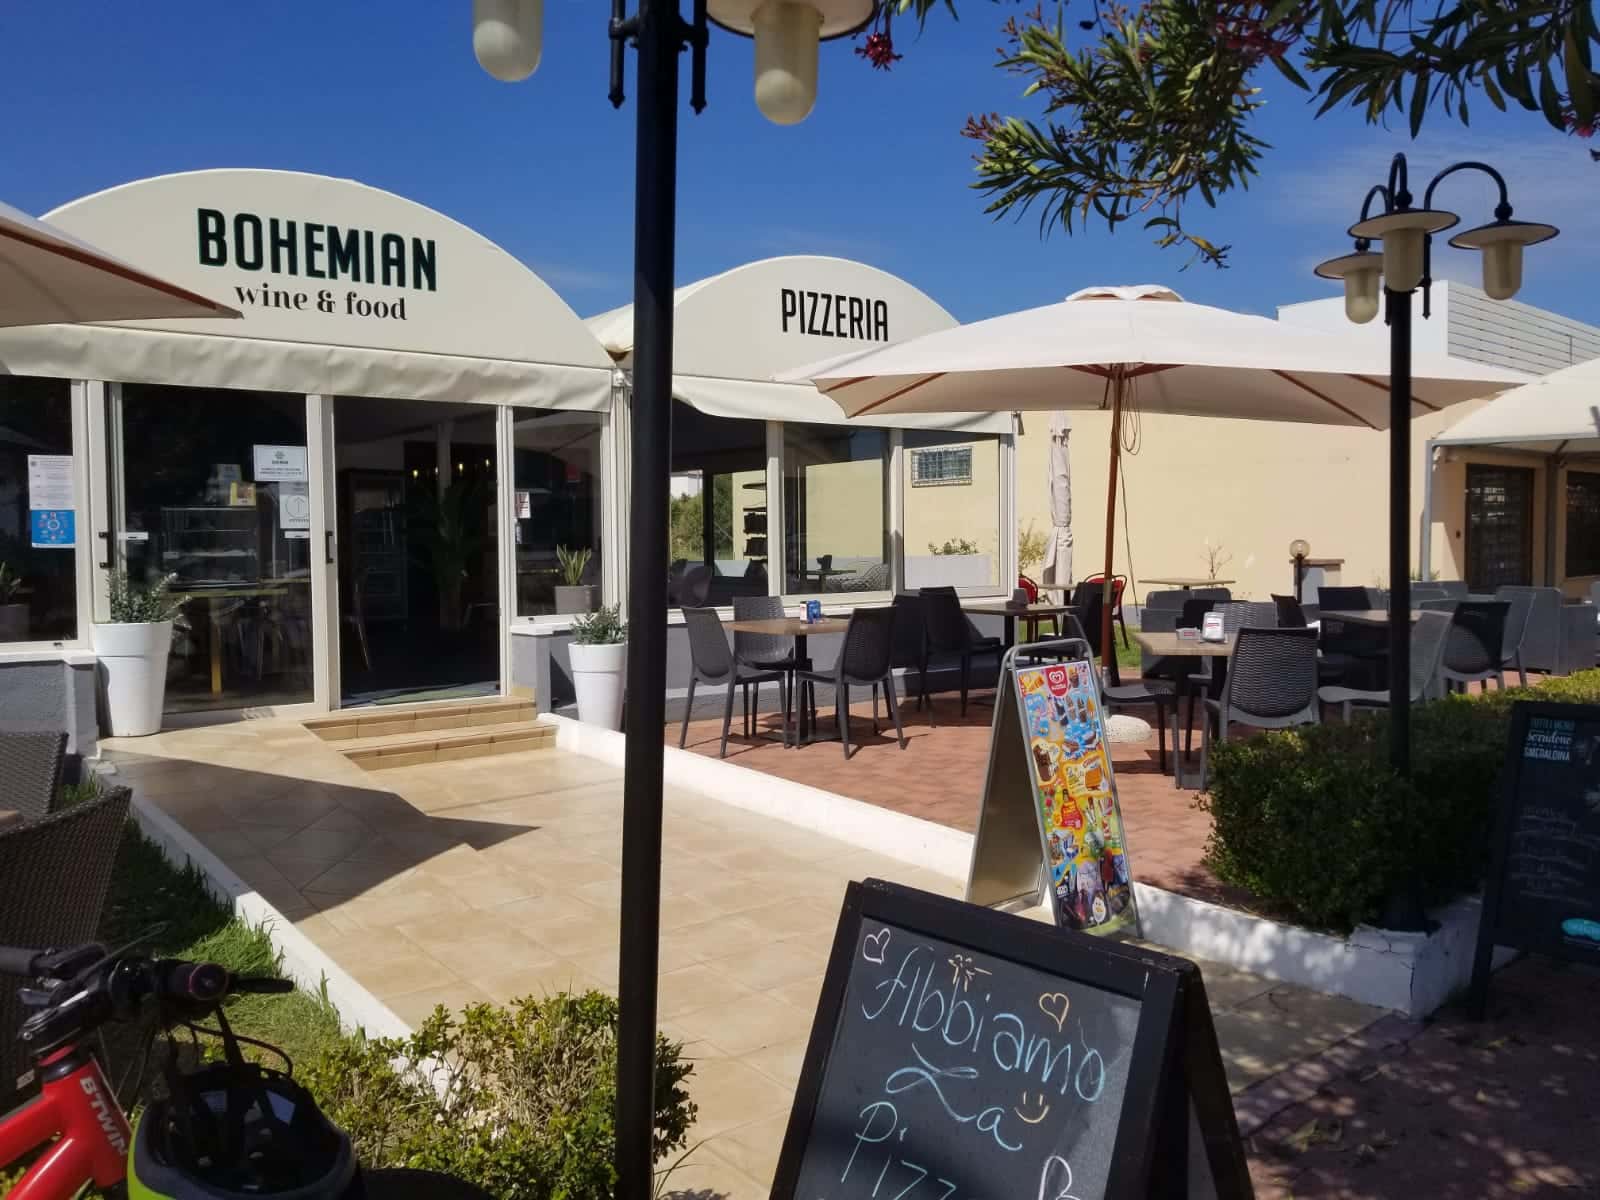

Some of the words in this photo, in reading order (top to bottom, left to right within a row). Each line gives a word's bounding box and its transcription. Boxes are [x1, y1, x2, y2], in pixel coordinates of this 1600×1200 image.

[197, 208, 437, 292] BOHEMIAN
[234, 283, 311, 311] wine
[316, 290, 336, 314] &
[345, 291, 408, 321] food
[781, 288, 889, 342] PIZZERIA
[861, 945, 1104, 1101] Abbiamo
